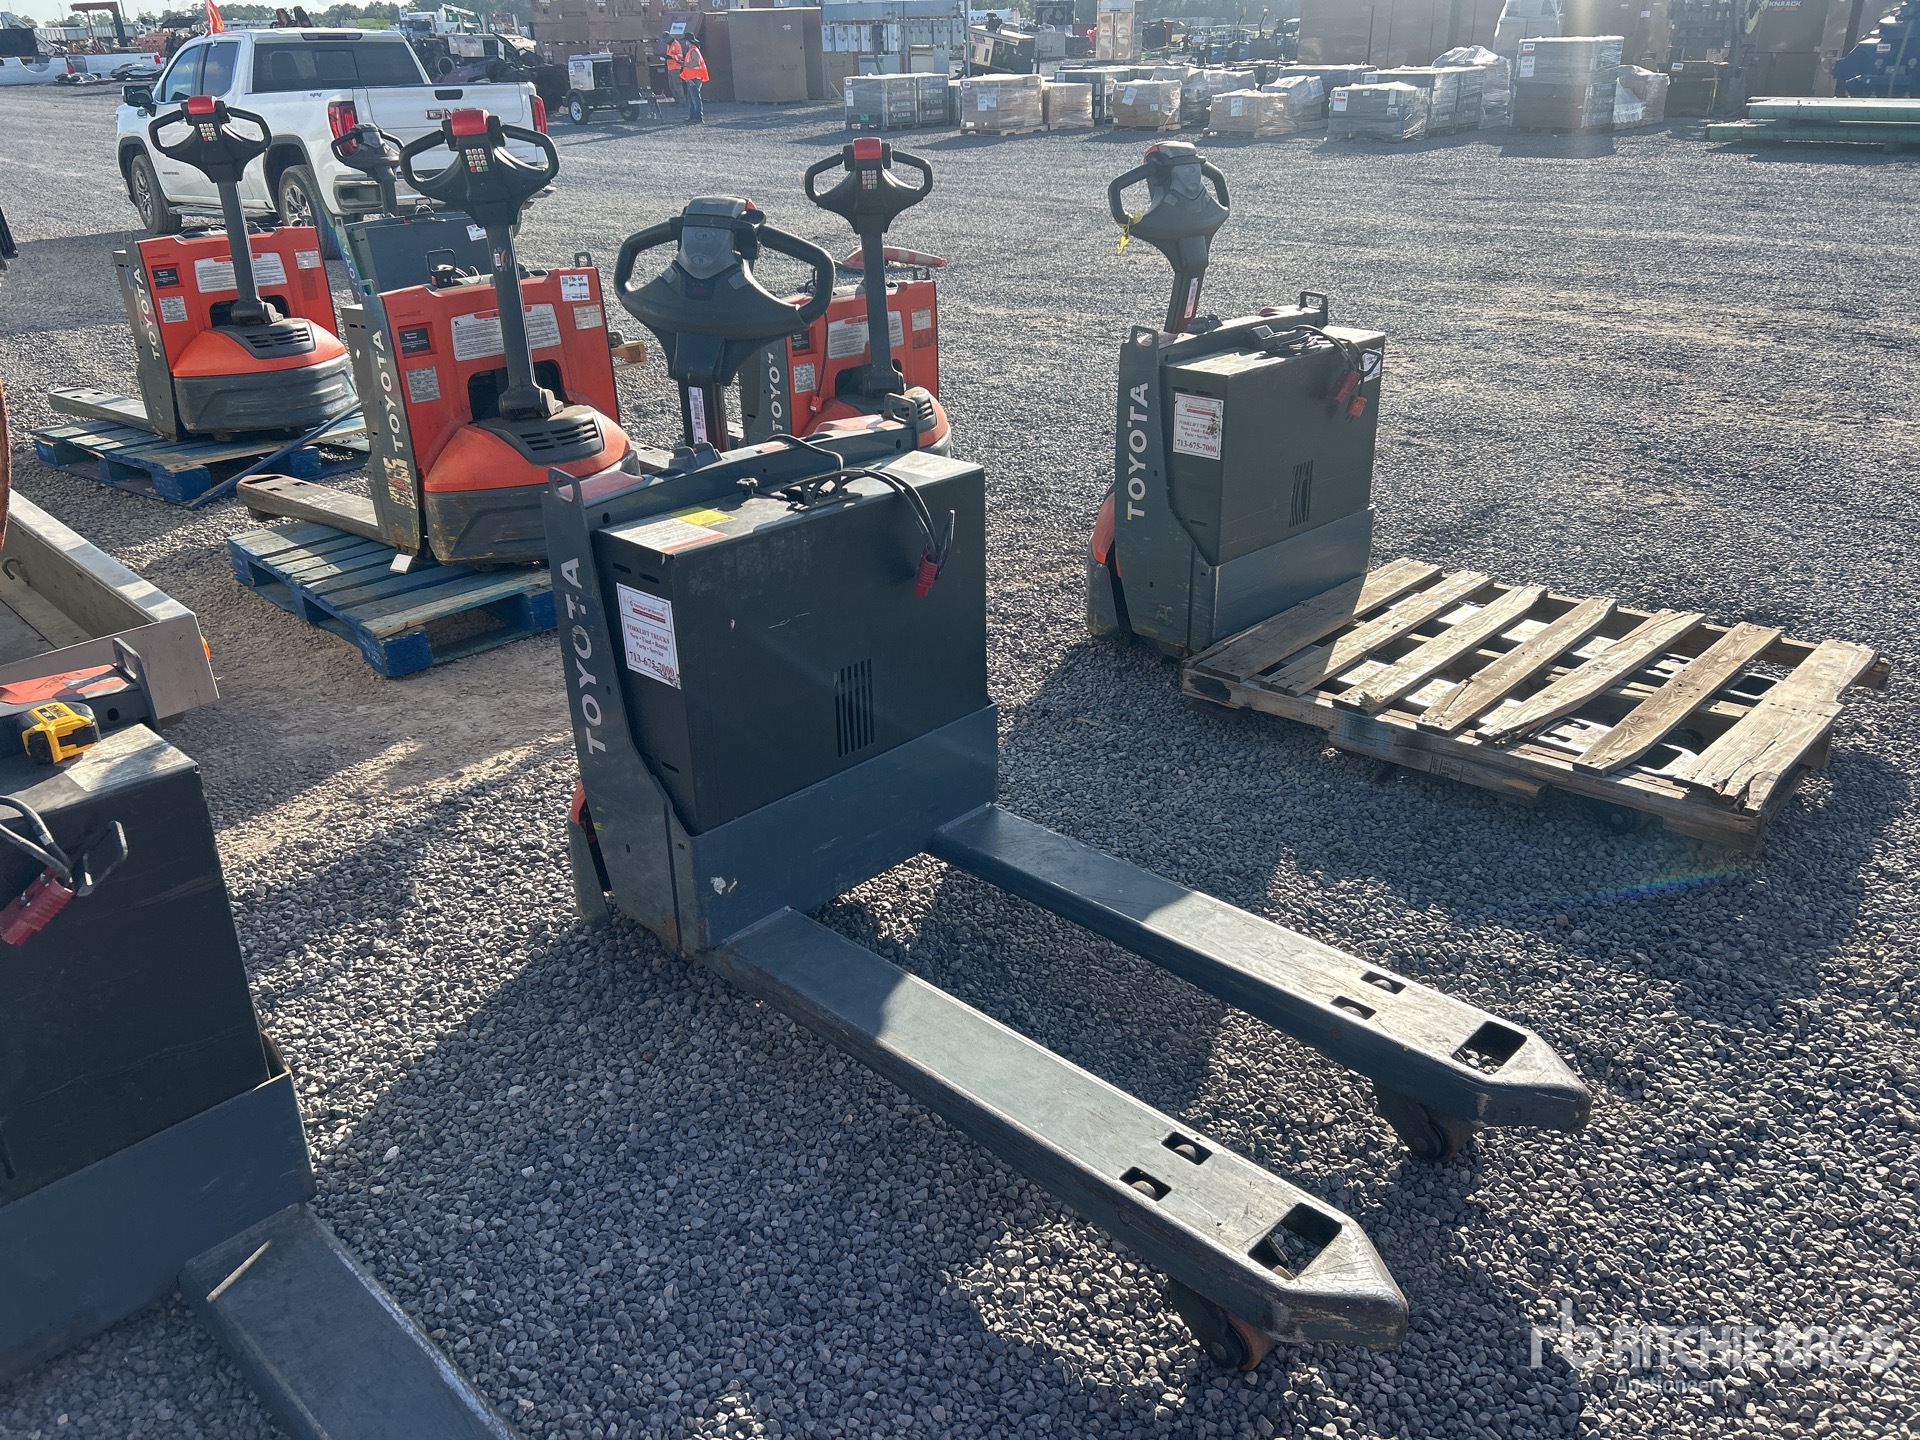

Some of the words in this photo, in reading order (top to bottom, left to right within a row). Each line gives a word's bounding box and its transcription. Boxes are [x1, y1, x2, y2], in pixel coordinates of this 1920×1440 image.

[425, 108, 477, 120] GM
[133, 268, 161, 360] TOYOTA
[372, 330, 404, 452] TOYOTA
[1179, 420, 1200, 428] FORKLIFT
[1127, 382, 1149, 521] TOYOTA
[1177, 439, 1217, 453] 713-675-7000
[627, 623, 650, 637] FORKLIFT
[650, 631, 670, 644] TRUCKS
[630, 632, 639, 640] New
[642, 636, 652, 645] Used
[561, 557, 607, 755] TOYOTA
[636, 641, 647, 650] Parts
[649, 646, 664, 657] Service
[629, 651, 675, 677] 713-675-7000
